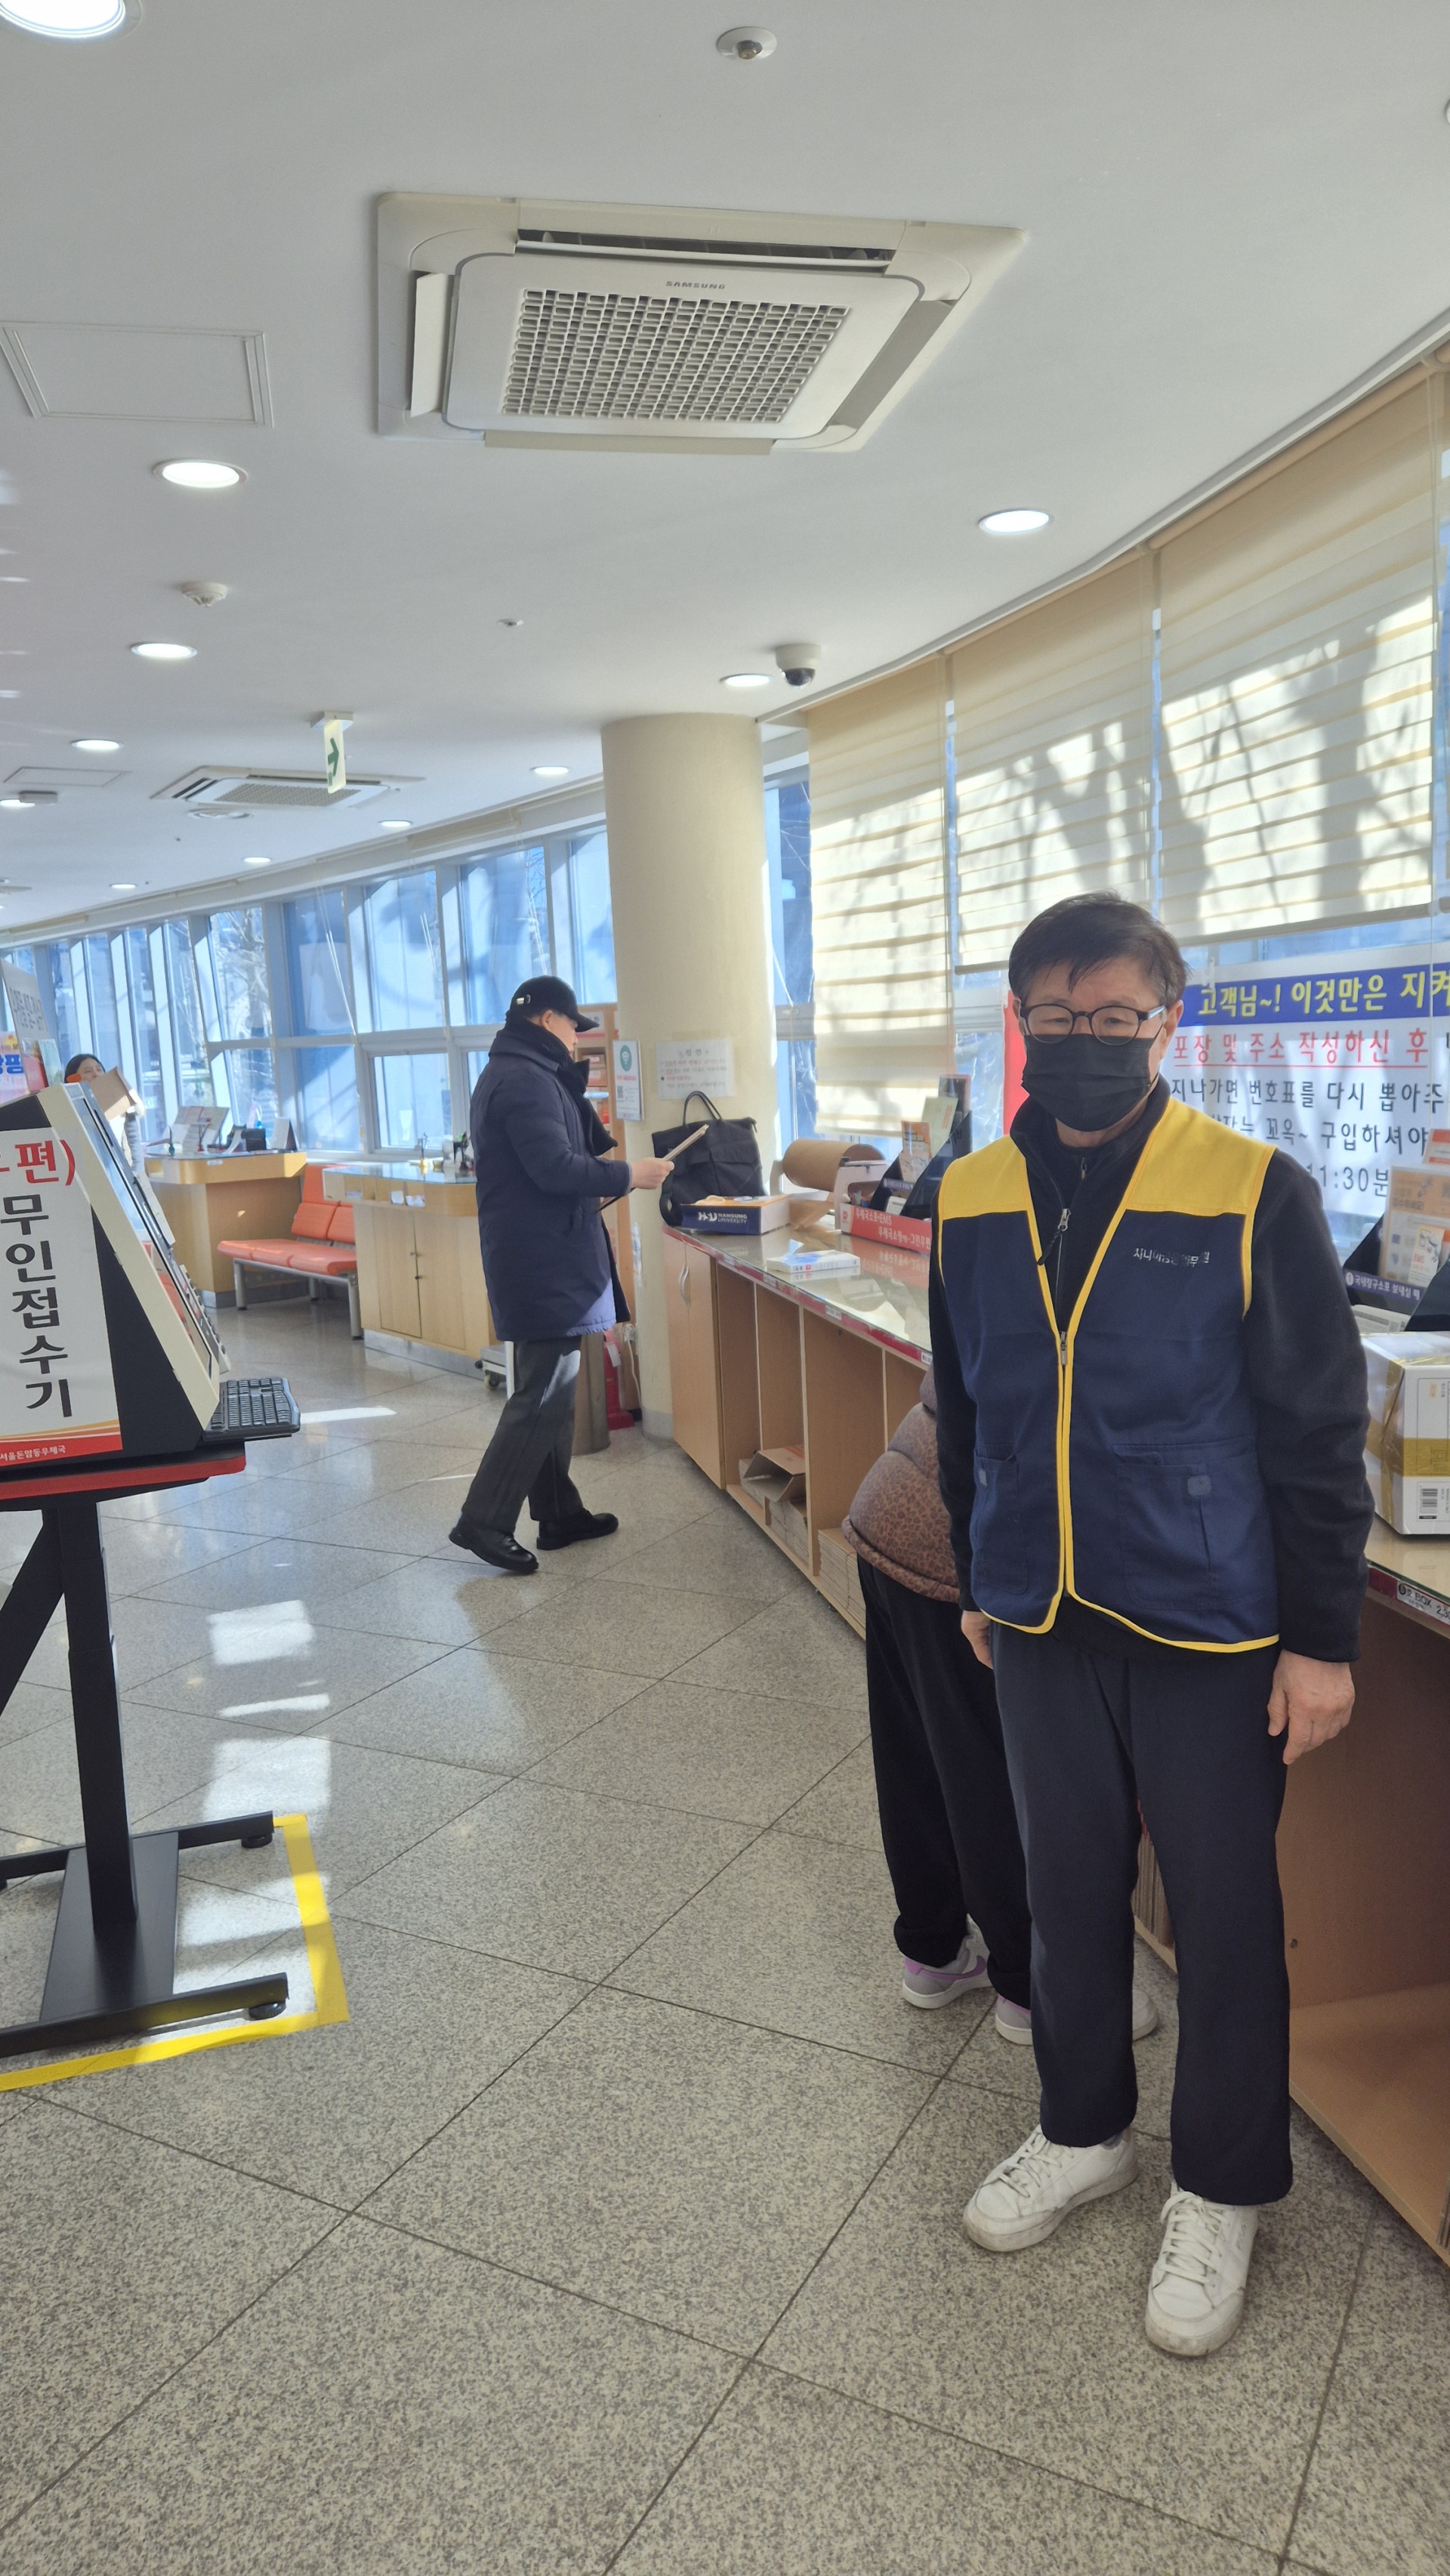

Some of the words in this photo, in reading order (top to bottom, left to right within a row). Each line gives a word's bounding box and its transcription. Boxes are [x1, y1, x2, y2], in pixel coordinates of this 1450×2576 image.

[665, 281, 726, 289] SAMSUNG
[1199, 984, 1281, 1018] 고객님~!
[1291, 974, 1387, 1015] 이것만은
[1173, 1033, 1212, 1063] 포장
[1223, 1033, 1238, 1063] 및
[1249, 1032, 1285, 1063] 주소
[1299, 1030, 1390, 1064] 작성하신
[1406, 1027, 1429, 1064] 후
[1171, 1079, 1239, 1104] 지나가면
[1249, 1080, 1315, 1108] 번호표를
[1328, 1082, 1365, 1110] 다시
[1379, 1083, 1445, 1113] 뽑아주
[1266, 1117, 1309, 1146] 꼬옥~
[1322, 1121, 1429, 1157] 구입하셔야
[0, 1139, 76, 1186] 편)
[1, 1194, 73, 1418] 무인접수기
[1415, 1592, 1432, 1608] BOX
